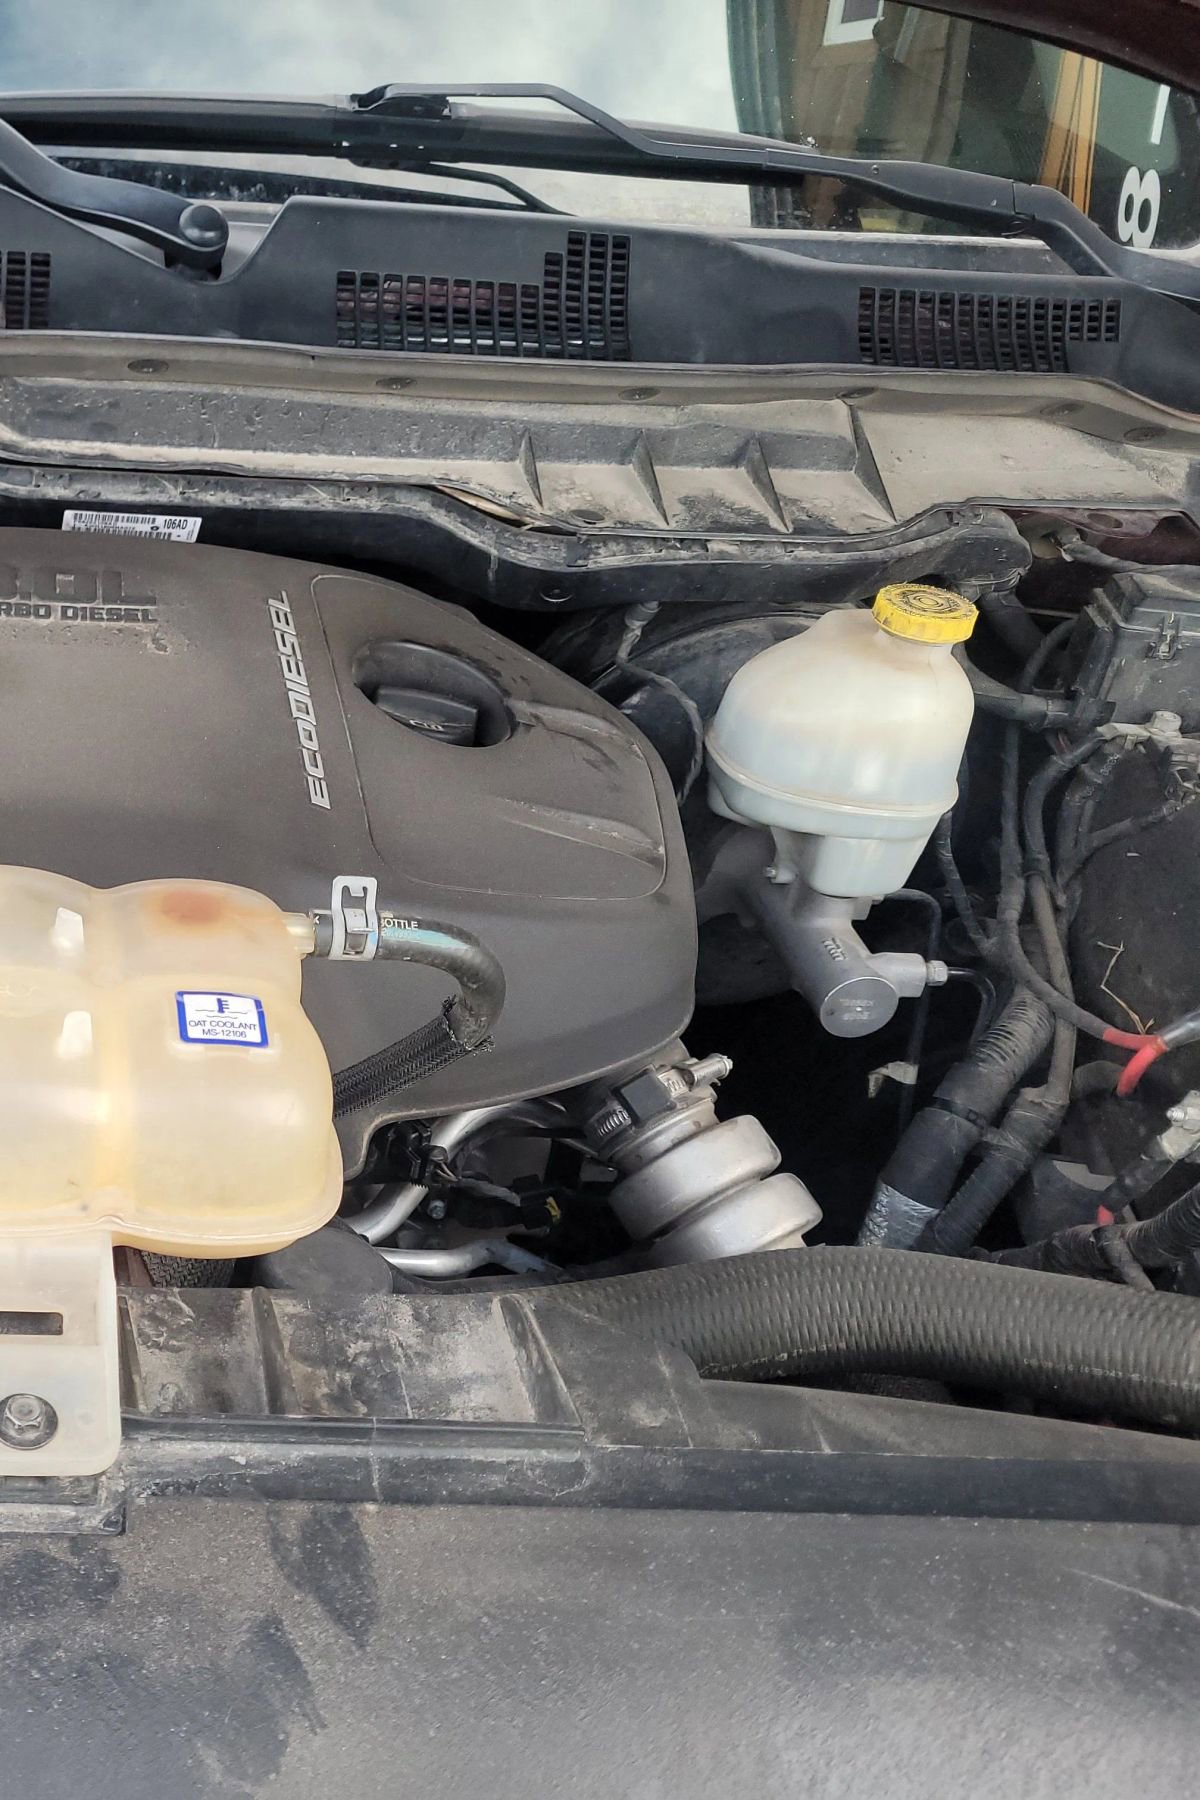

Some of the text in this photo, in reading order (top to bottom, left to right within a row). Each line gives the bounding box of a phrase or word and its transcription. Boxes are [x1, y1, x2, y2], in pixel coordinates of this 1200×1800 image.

[163, 518, 188, 530] 106AD
[60, 604, 158, 624] DIESEL
[268, 590, 332, 810] ECODIESEL
[209, 1020, 257, 1031] COOLANT
[202, 1028, 247, 1039] MS-12106
